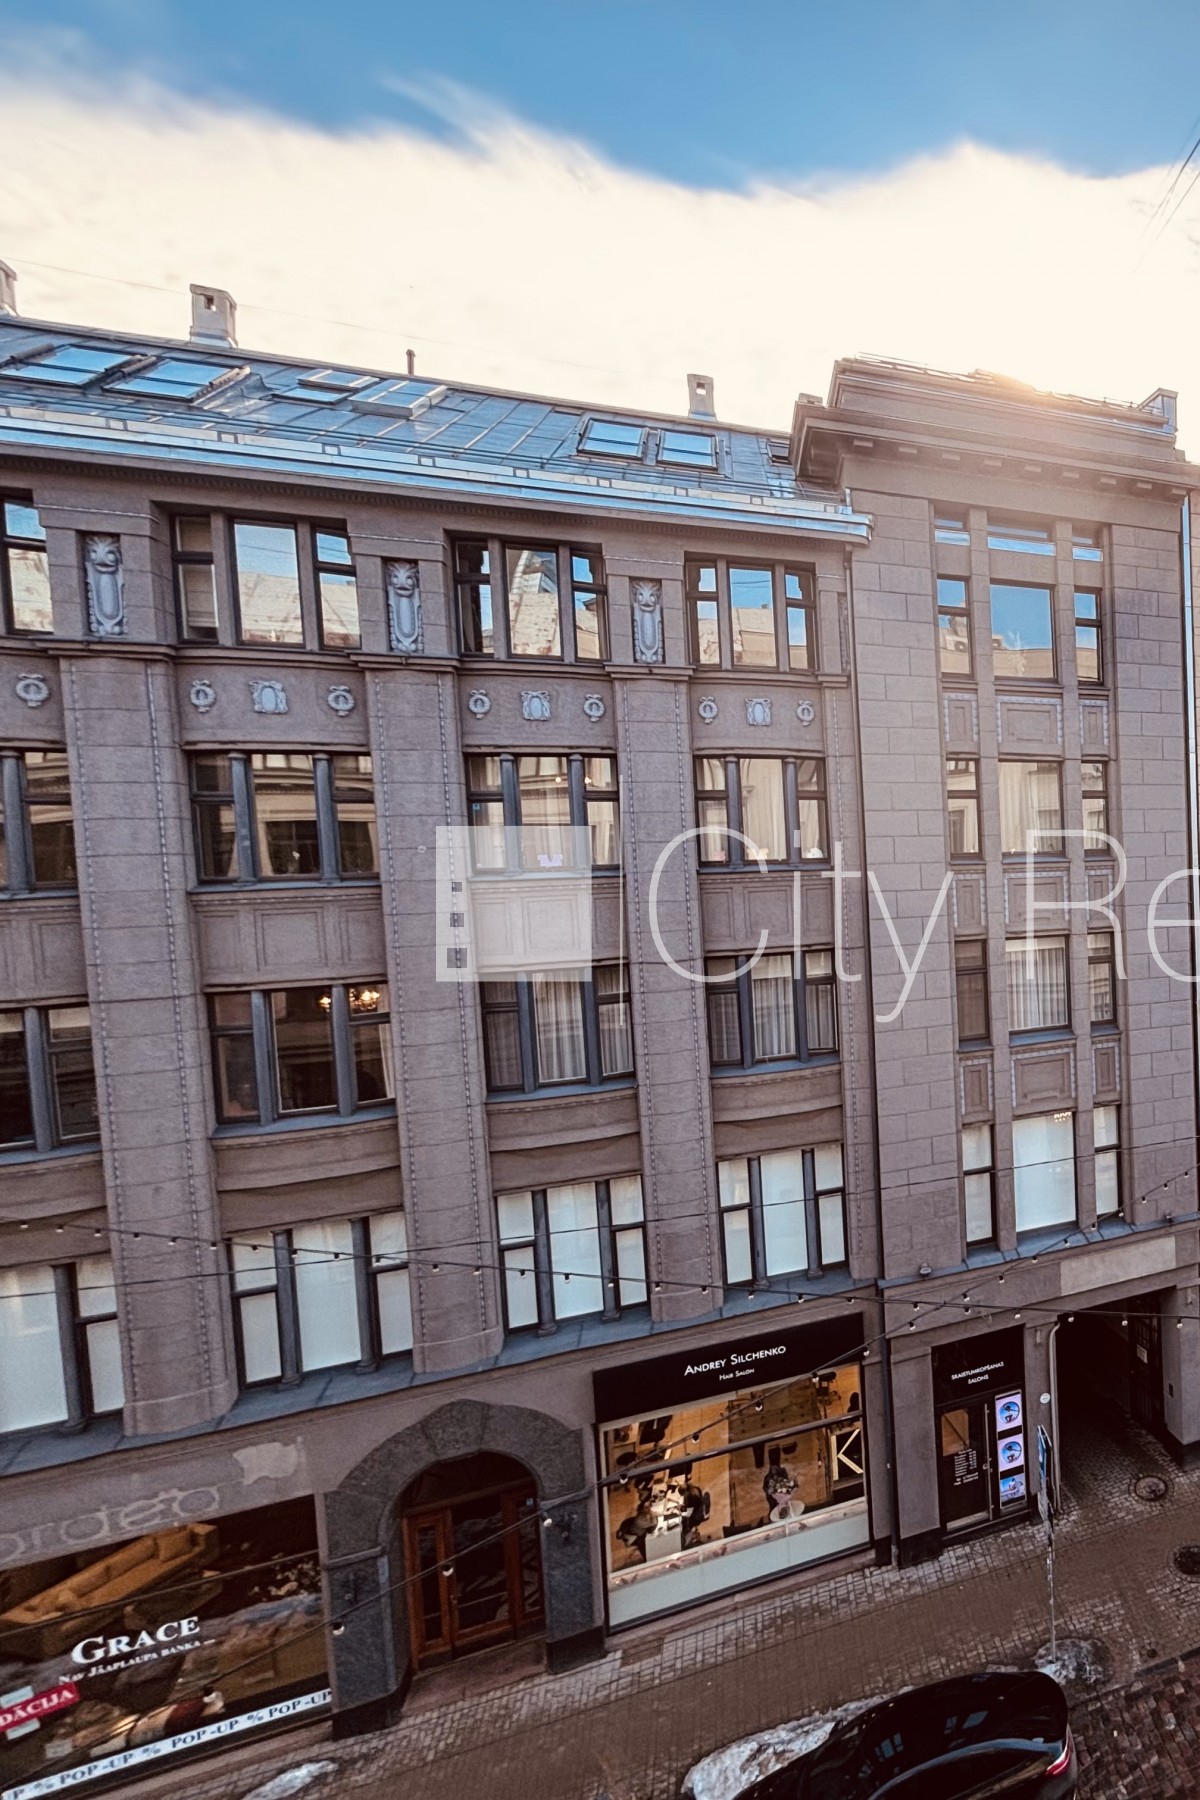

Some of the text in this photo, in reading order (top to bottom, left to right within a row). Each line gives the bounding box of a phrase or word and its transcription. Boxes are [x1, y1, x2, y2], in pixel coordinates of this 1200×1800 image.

[684, 1345, 787, 1377] ANDREY SILCHENKO
[71, 1616, 200, 1665] GRACE
